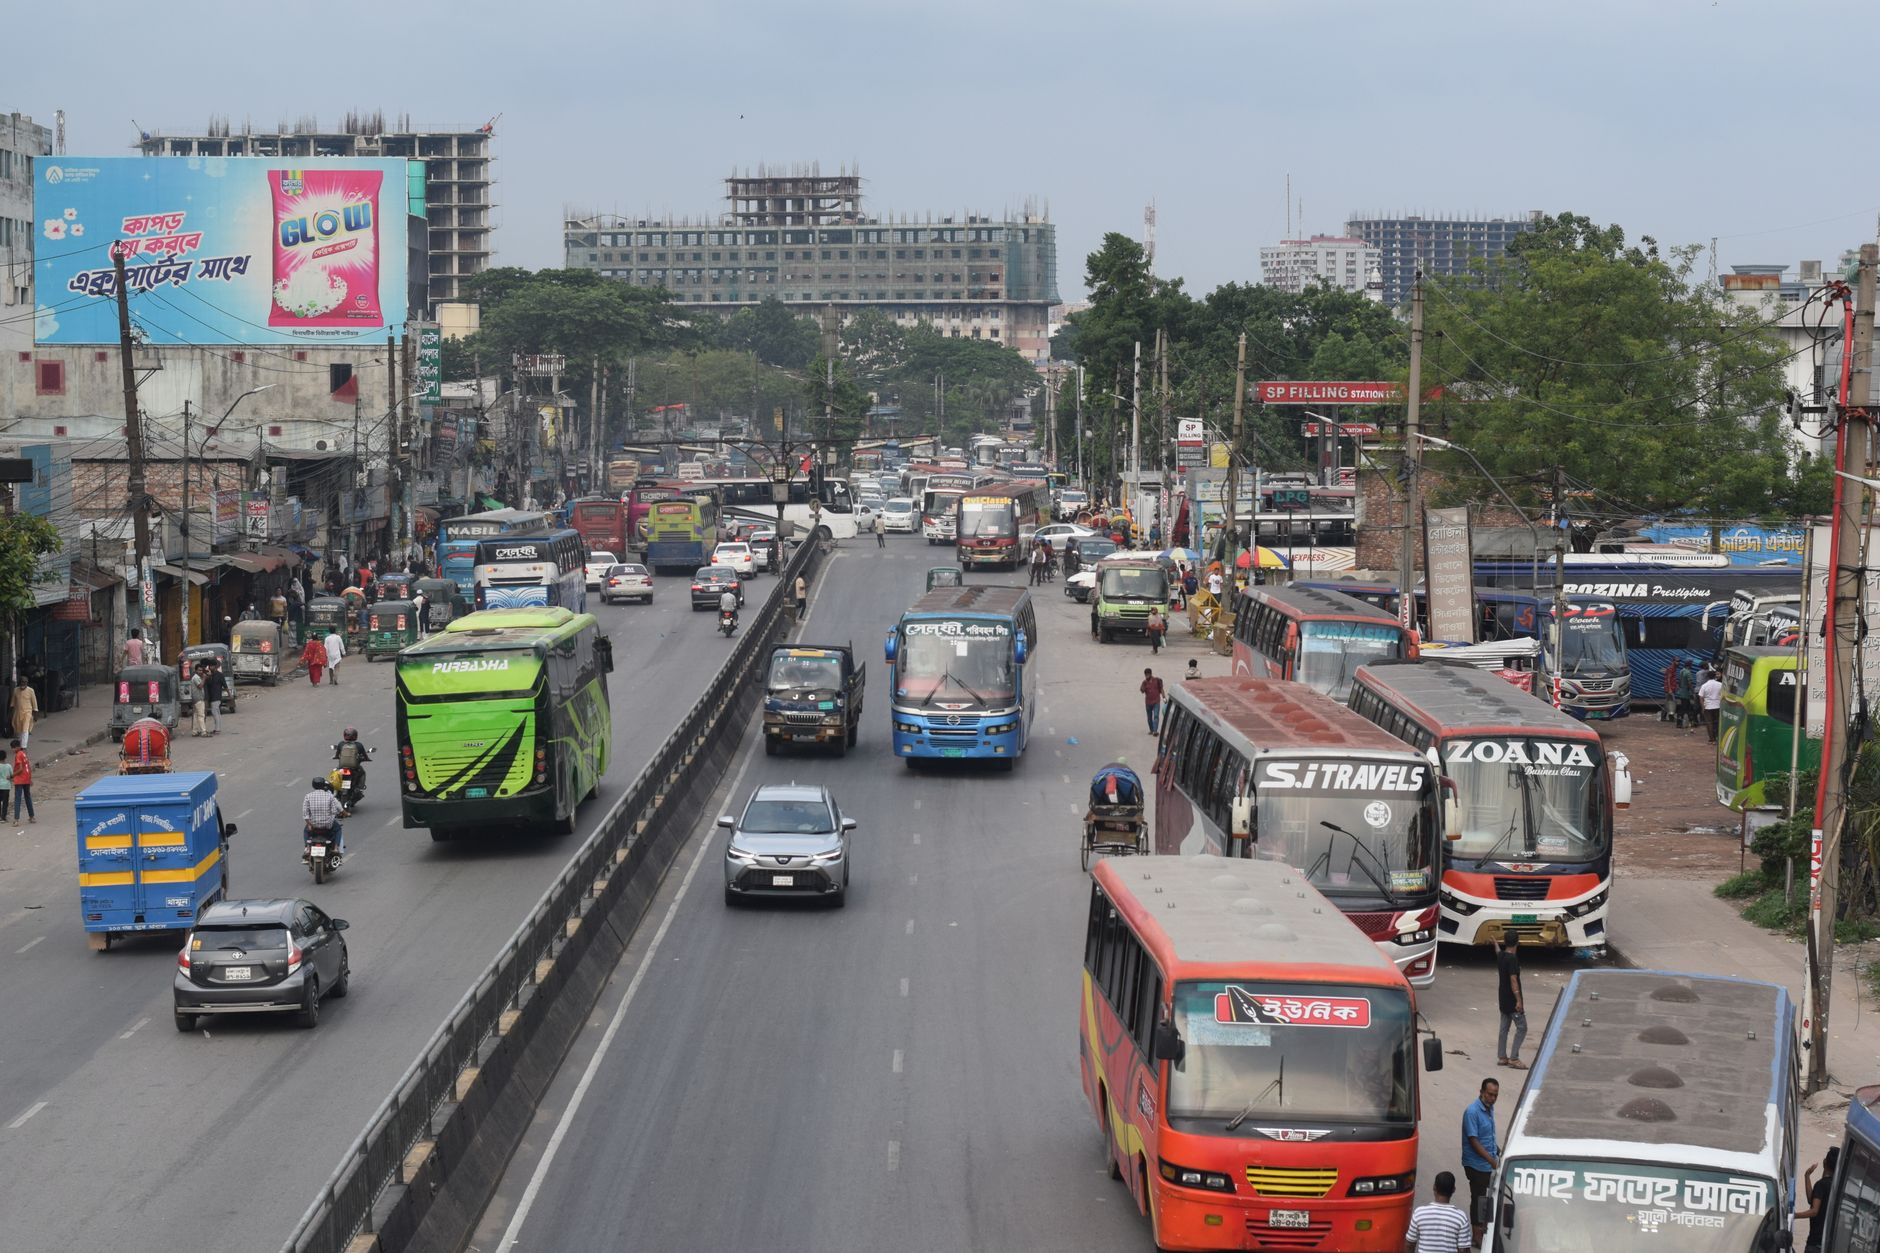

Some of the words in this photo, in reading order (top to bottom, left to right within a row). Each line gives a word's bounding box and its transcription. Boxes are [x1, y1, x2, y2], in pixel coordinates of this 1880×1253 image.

[123, 212, 184, 236] কাপড়
[280, 202, 372, 248] GLOW
[144, 233, 202, 256] করবে
[198, 255, 251, 281] সাথে
[1267, 386, 1285, 399] SP
[1290, 386, 1348, 399] FILLING
[1350, 390, 1384, 399] STATION
[1275, 491, 1309, 502] LPG
[448, 526, 499, 536] NABIL
[1429, 524, 1466, 540] রোজিনা
[1293, 554, 1326, 562] EXPRESS
[1562, 584, 1648, 597] ROZINA
[1652, 585, 1711, 600] Prestigious
[906, 622, 965, 637] সেলফী
[432, 660, 509, 674] PURBASHA
[1446, 740, 1596, 768] ZOANA
[1320, 764, 1425, 792] TRAVELS
[1524, 766, 1559, 776] Business
[1560, 766, 1581, 777] Class
[1262, 998, 1360, 1023] ইউনিক
[1513, 1168, 1576, 1205] শাহ্
[1583, 1172, 1679, 1213] ফতেহ্
[1684, 1177, 1768, 1216] আলী
[1670, 1210, 1726, 1228] পরিবহন
